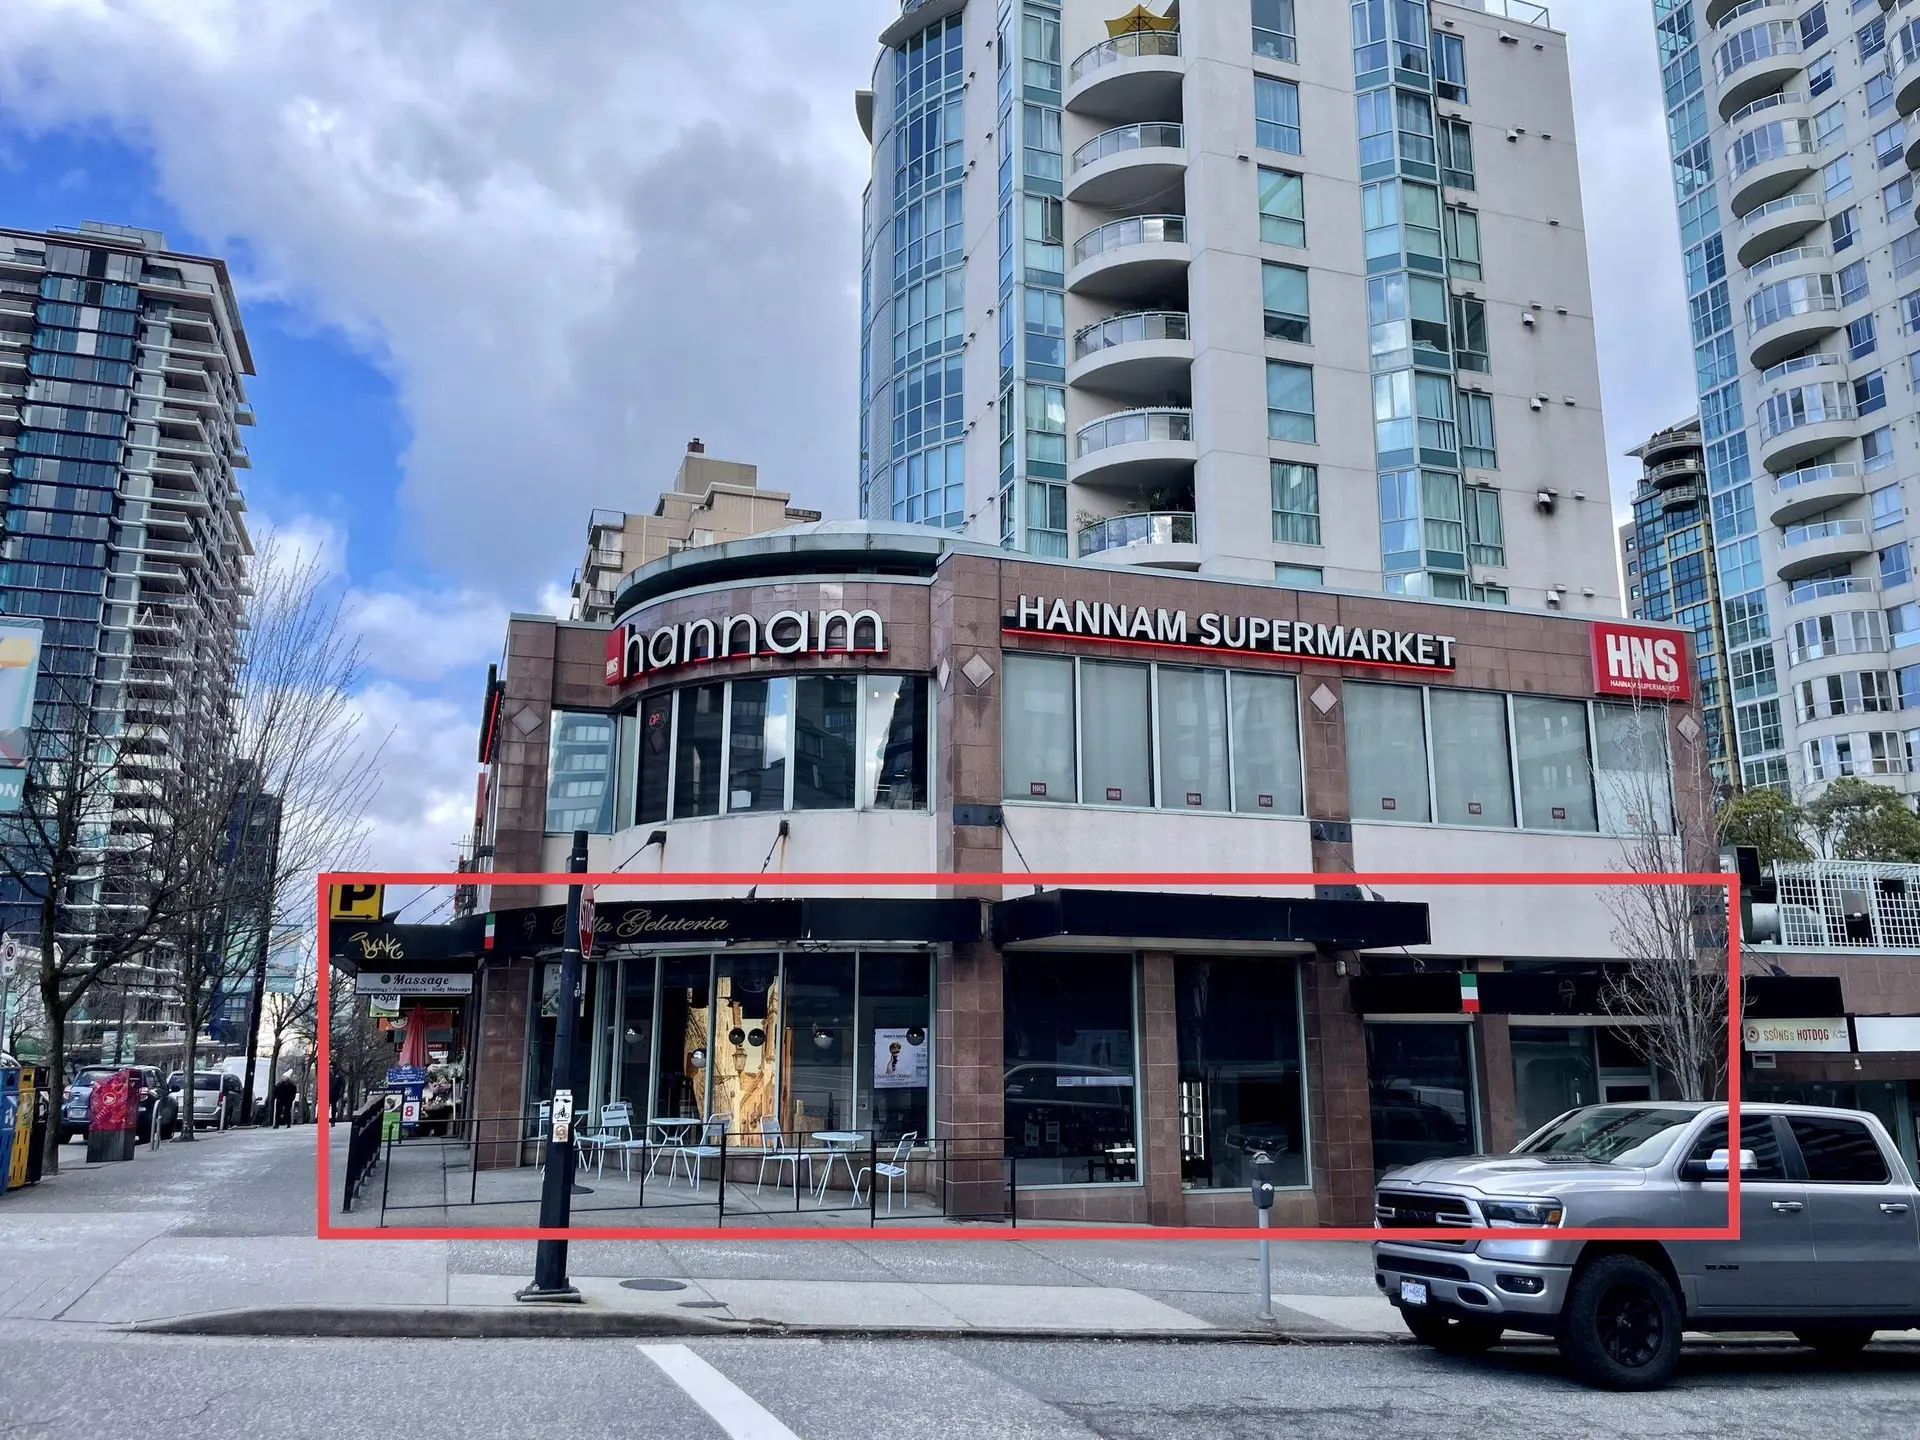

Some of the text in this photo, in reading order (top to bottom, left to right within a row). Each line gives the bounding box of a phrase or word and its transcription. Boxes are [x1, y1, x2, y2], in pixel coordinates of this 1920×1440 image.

[623, 609, 883, 677] hannam
[1018, 594, 1456, 666] HANNAM SUPERMARKET
[1605, 634, 1679, 683] HNS
[1610, 680, 1680, 692] HANNAM SUPERMARKET
[340, 884, 376, 911] P
[581, 901, 595, 934] STOP
[616, 909, 729, 937] Gelateria
[393, 974, 449, 988] Massage
[1796, 1028, 1830, 1043] HOTDOG
[1705, 1263, 1740, 1271] RAM
